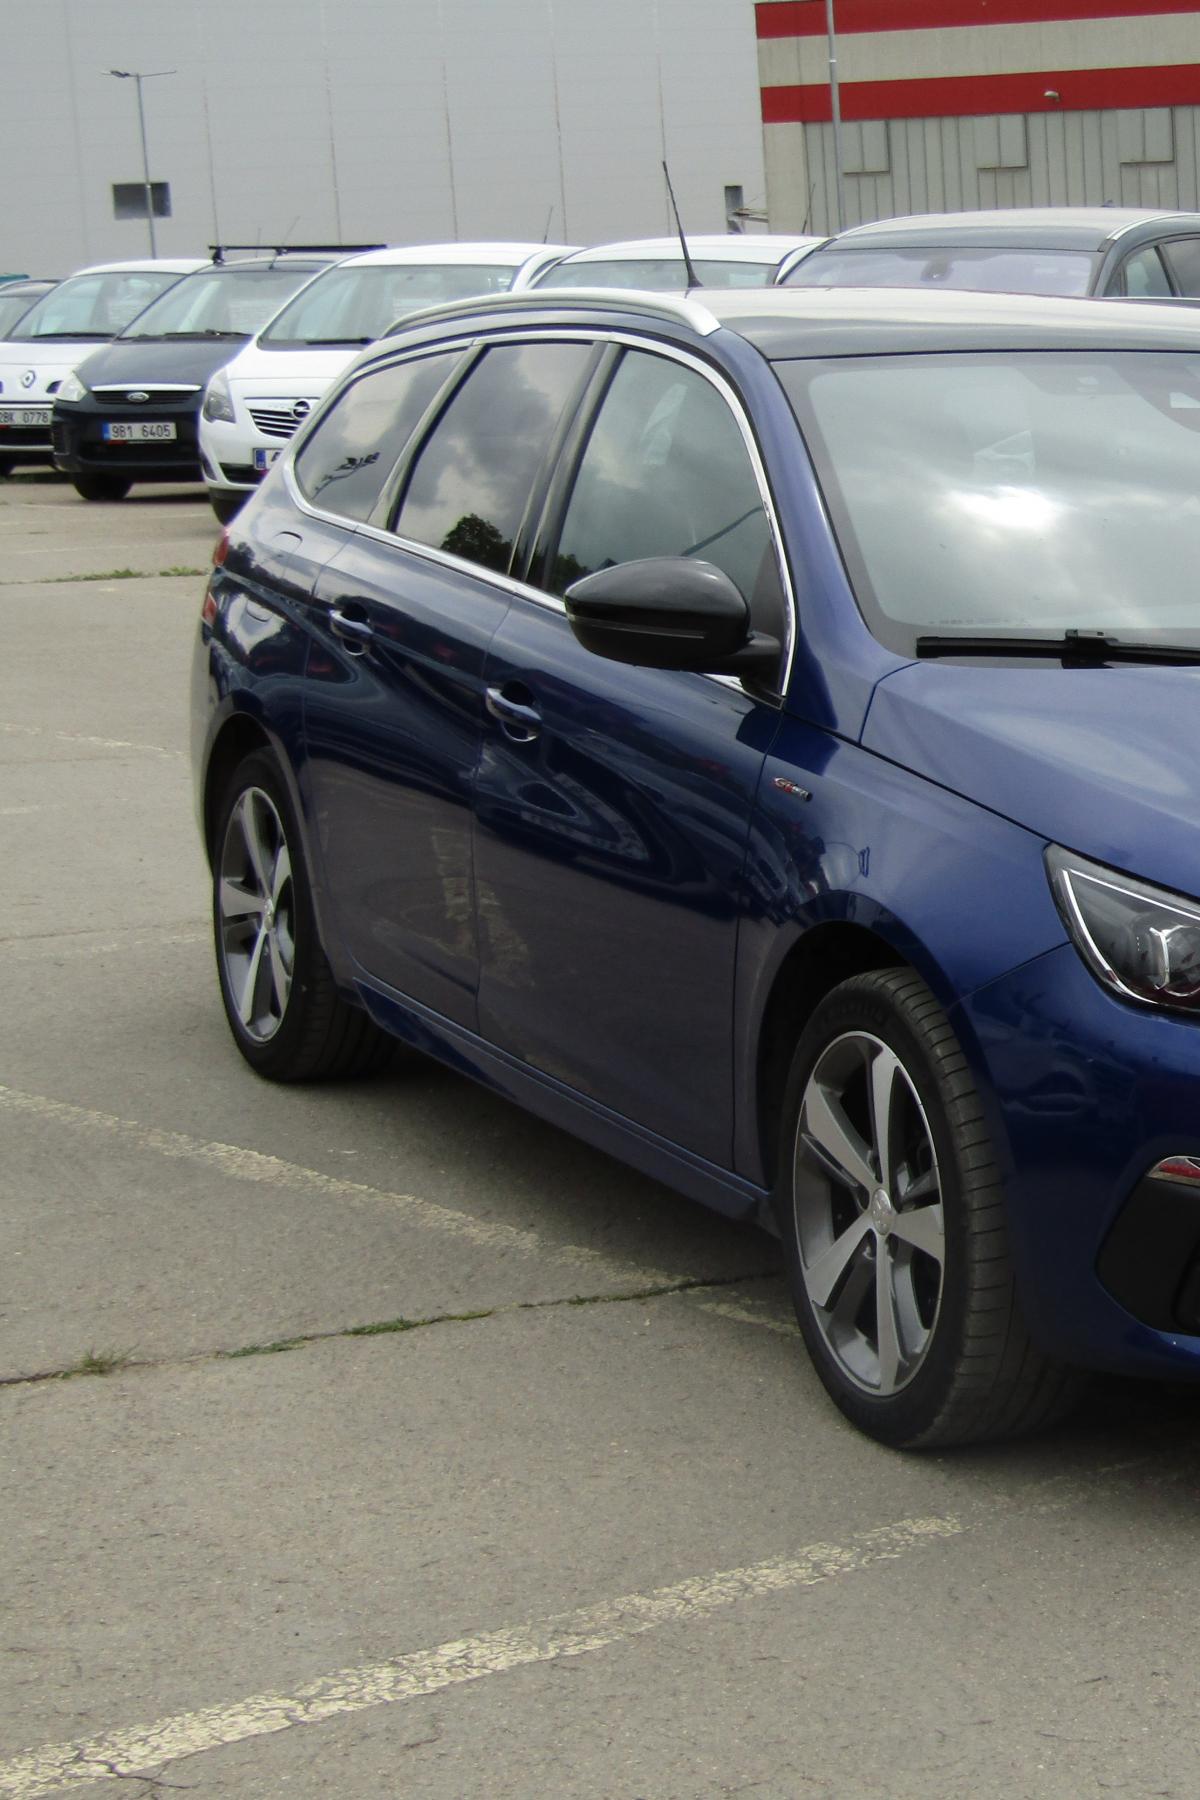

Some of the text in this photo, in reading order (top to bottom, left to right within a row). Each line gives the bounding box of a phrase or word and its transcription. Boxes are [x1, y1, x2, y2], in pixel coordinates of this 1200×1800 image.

[23, 411, 49, 424] 0778
[112, 424, 171, 438] 9B1 6405
